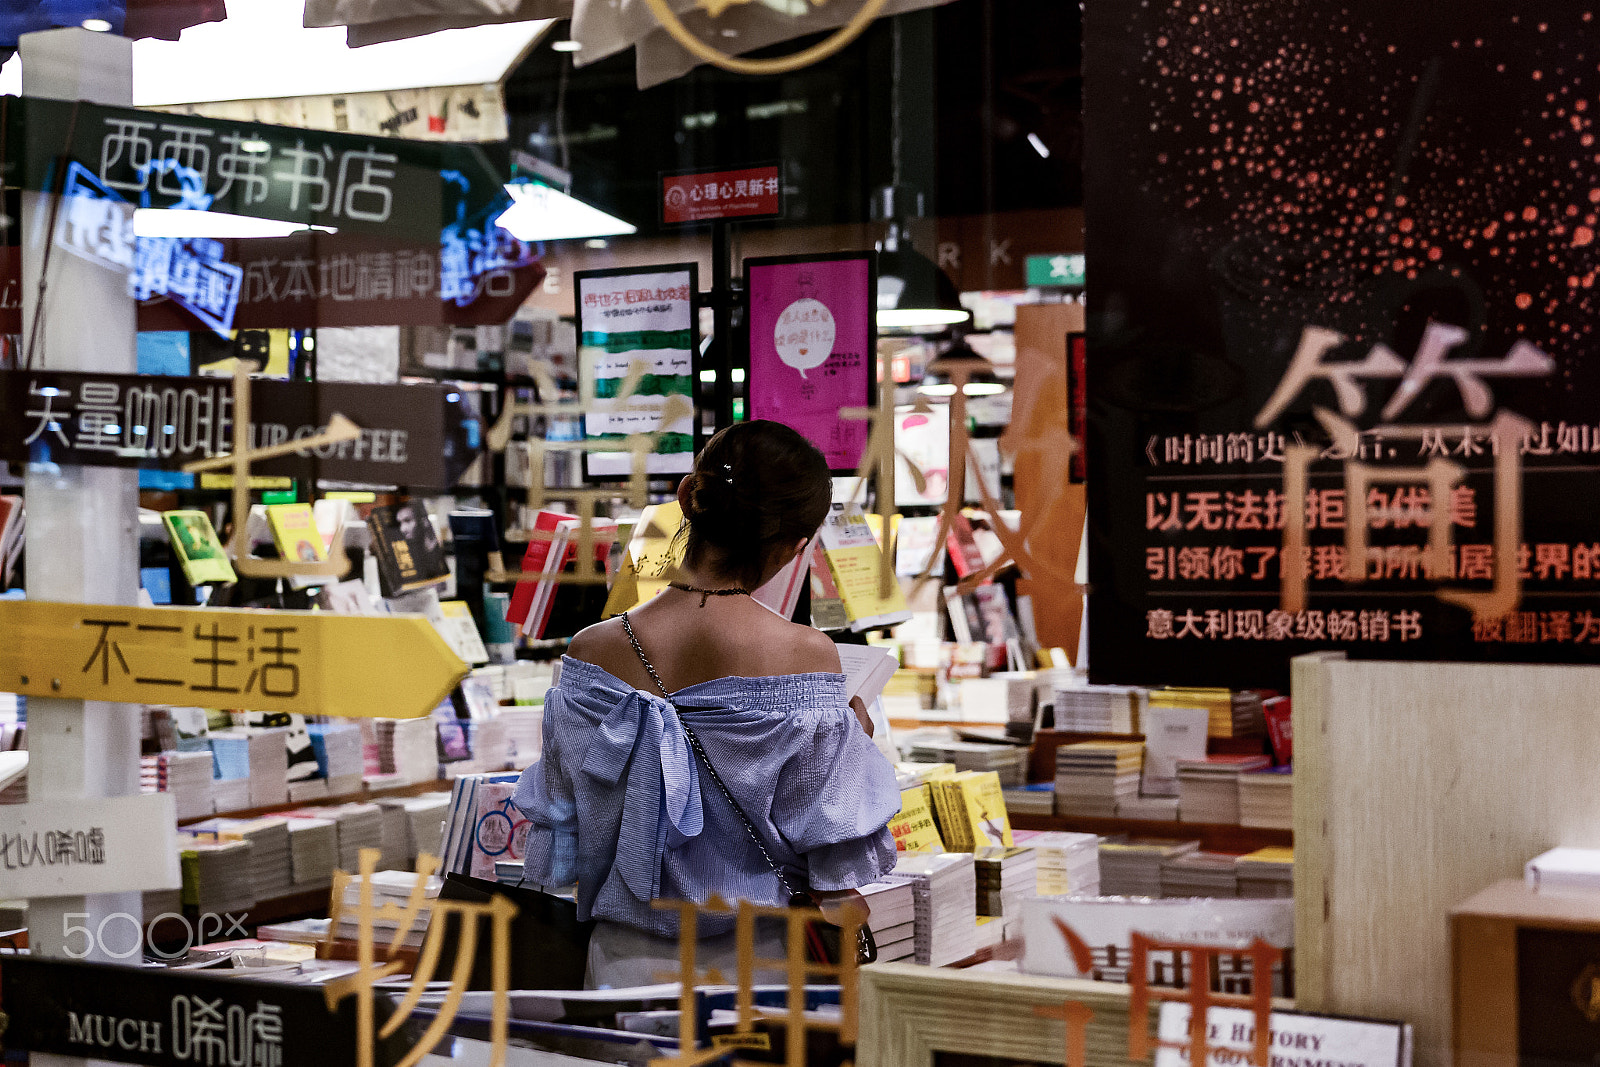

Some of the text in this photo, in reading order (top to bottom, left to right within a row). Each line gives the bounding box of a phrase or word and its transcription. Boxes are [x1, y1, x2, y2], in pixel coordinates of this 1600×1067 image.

[101, 117, 398, 222] 西西弗书店
[690, 177, 779, 201] 心理心灵新书
[293, 424, 409, 463] COFFEE
[1146, 609, 1422, 642] 意大利现象级畅销书
[82, 618, 301, 698] 不二生活
[68, 994, 284, 1067] MUCH 唏嘘
[1231, 1023, 1325, 1051] HITORY
